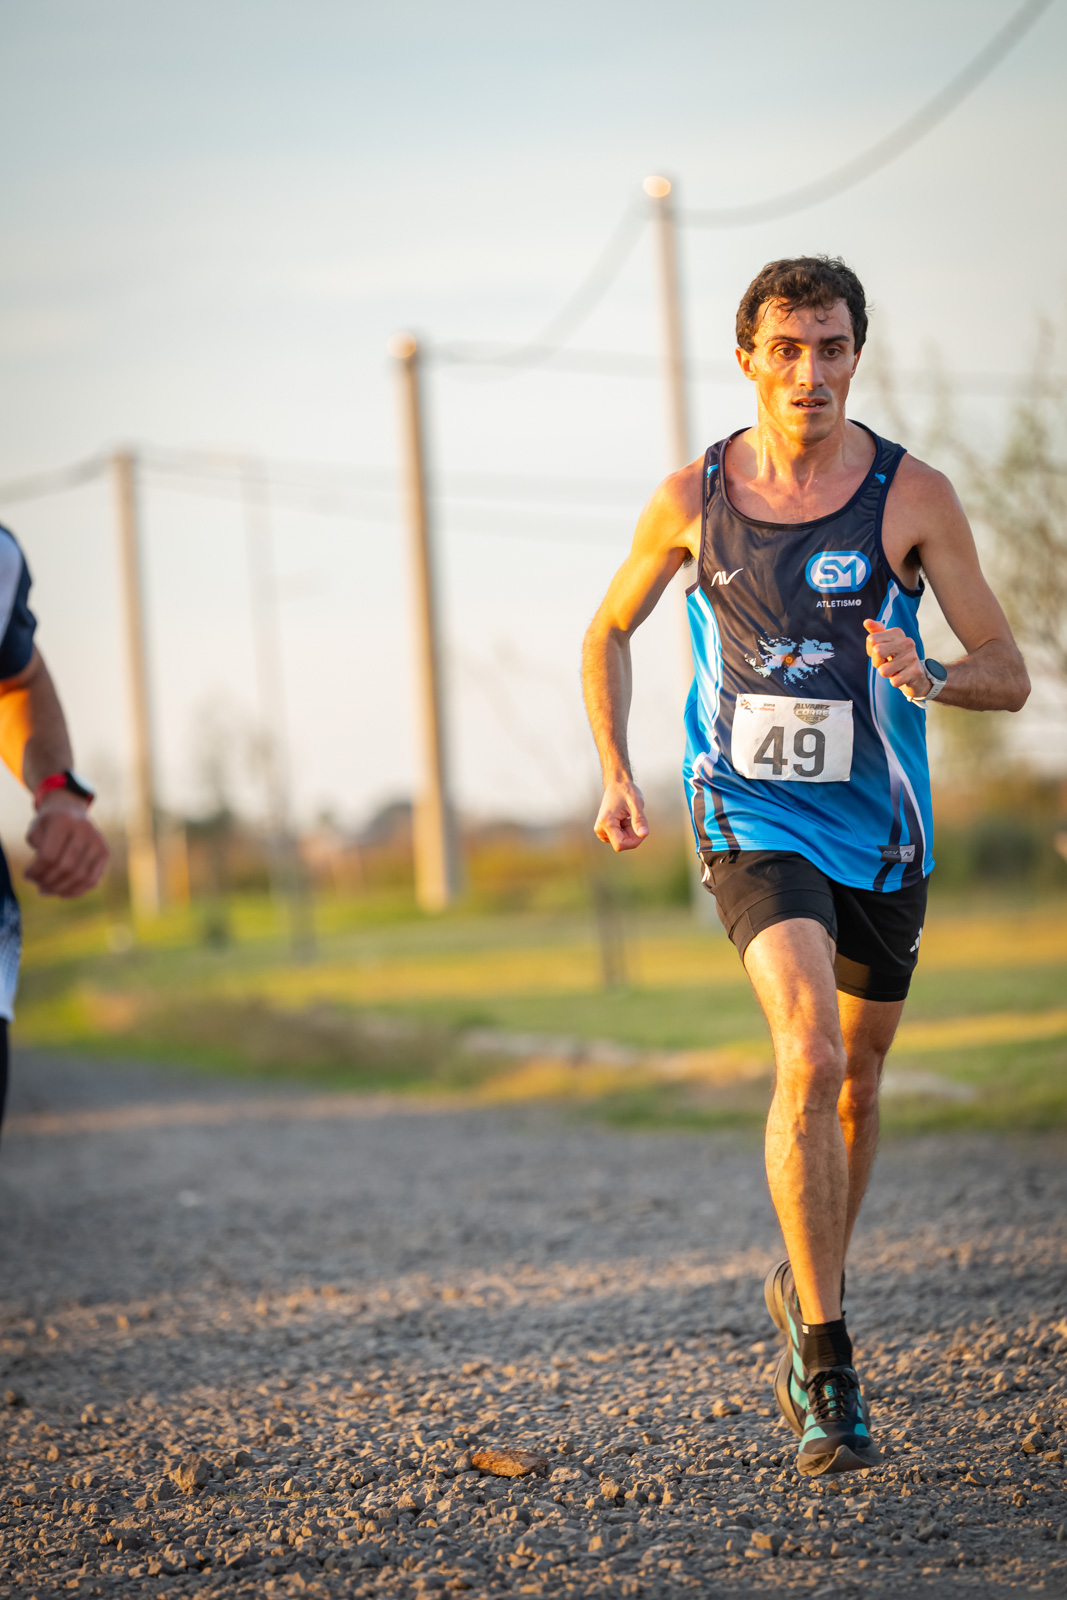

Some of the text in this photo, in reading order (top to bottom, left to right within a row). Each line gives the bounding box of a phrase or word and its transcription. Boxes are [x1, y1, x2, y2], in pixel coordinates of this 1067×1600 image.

[818, 558, 857, 591] SM
[816, 599, 862, 608] ATLETISMO
[754, 726, 825, 777] 49
